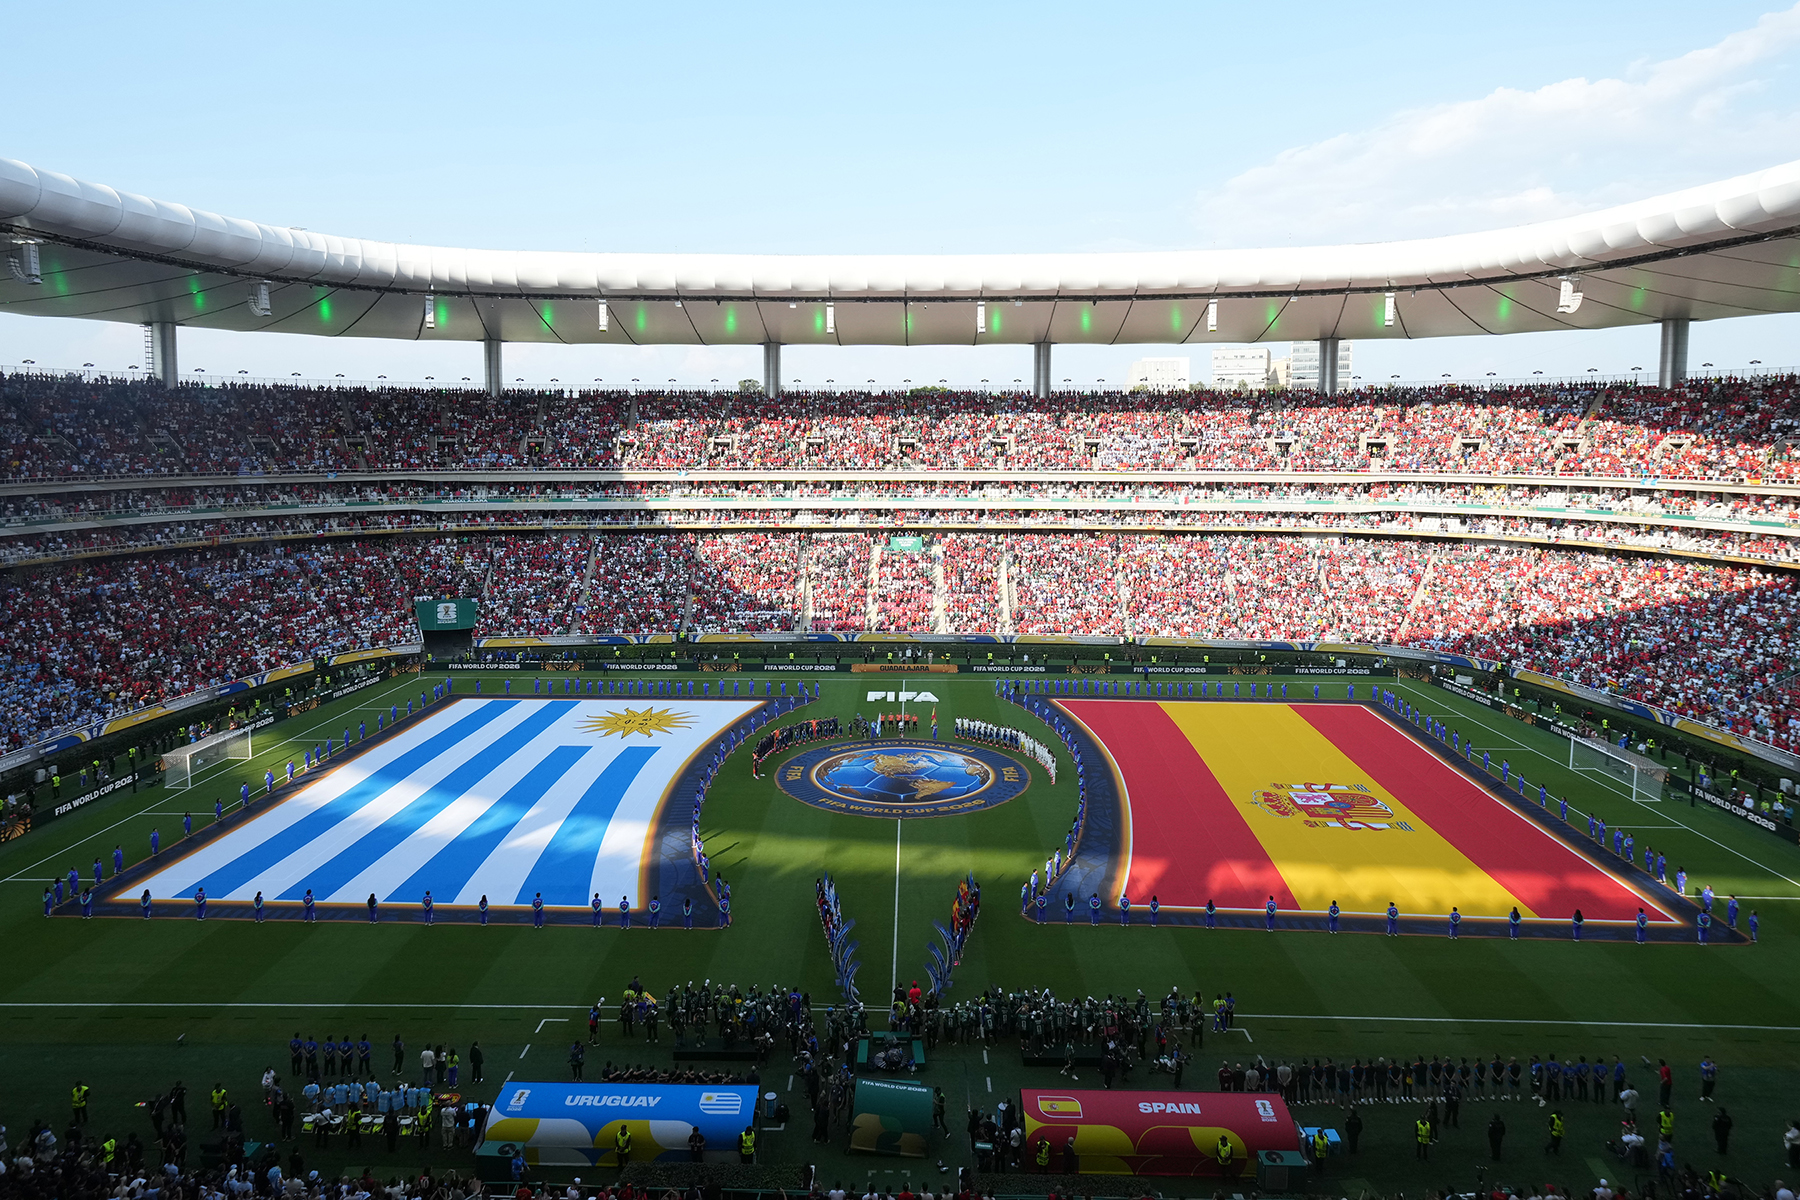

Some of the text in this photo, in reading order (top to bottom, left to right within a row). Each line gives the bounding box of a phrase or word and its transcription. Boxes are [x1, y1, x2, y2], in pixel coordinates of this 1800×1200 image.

[343, 685, 358, 696] WORLD
[358, 681, 366, 690] CUP
[366, 676, 380, 686] 2026
[1443, 681, 1491, 706] FIFA WORLD CUP 2026
[867, 691, 939, 702] FIFA
[256, 716, 274, 729] 2026
[1550, 724, 1562, 735] FIFA
[786, 766, 804, 780] FIFA
[1001, 766, 1019, 782] FIFA
[54, 803, 72, 817] FIFA
[72, 790, 100, 808] WORLD
[100, 783, 114, 796] CUP
[818, 798, 847, 810] FIFA
[849, 805, 903, 814] WORLD
[935, 799, 985, 812] 2026
[1704, 791, 1731, 810] WORLD
[1731, 804, 1747, 818] CUP
[1747, 812, 1776, 832] 2026
[565, 1095, 662, 1106] URUGUAY
[1138, 1102, 1201, 1114] SPAIN
